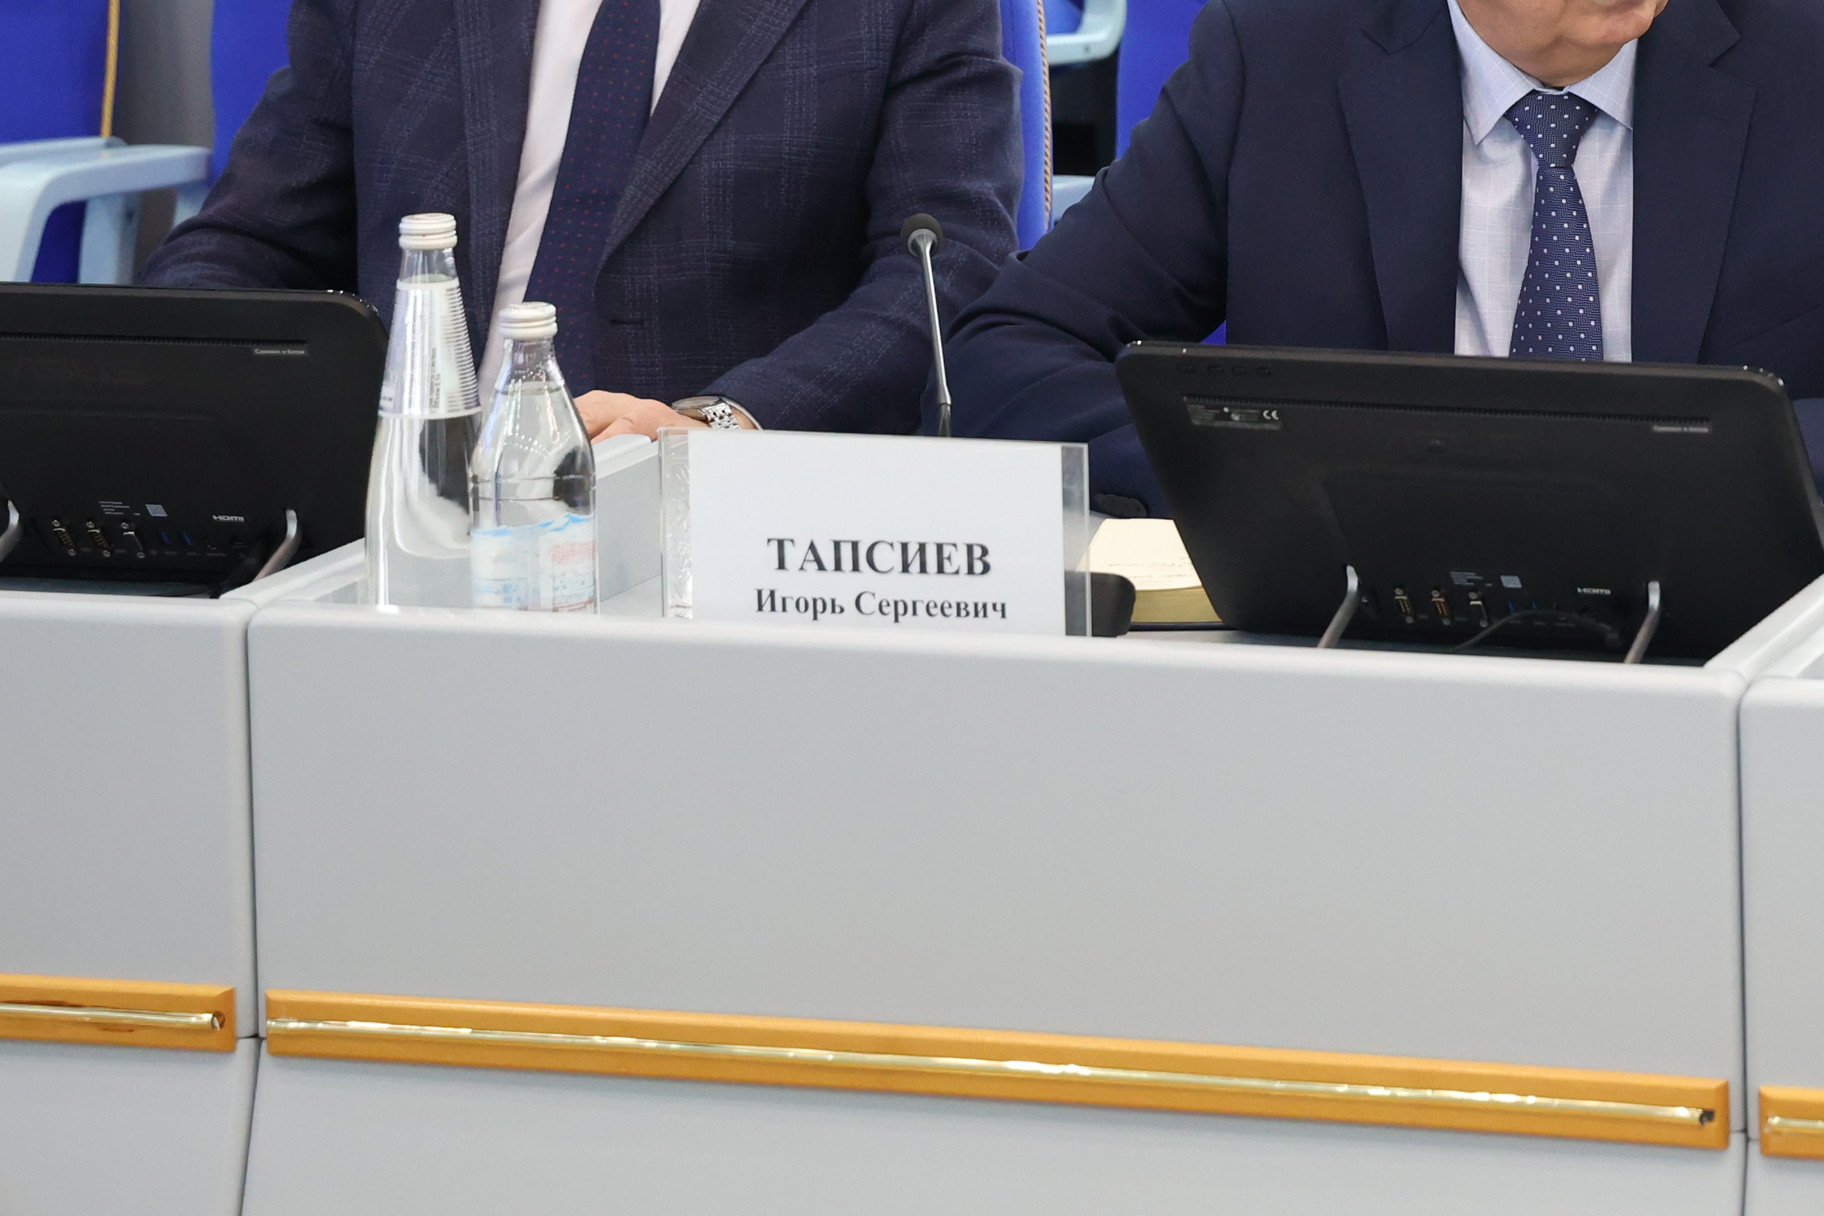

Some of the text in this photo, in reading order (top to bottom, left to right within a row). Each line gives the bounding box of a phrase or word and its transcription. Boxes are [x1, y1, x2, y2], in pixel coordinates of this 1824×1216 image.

[766, 538, 992, 577] ТАПСИЕВ
[755, 588, 1008, 624] Игорь Сергеевич
